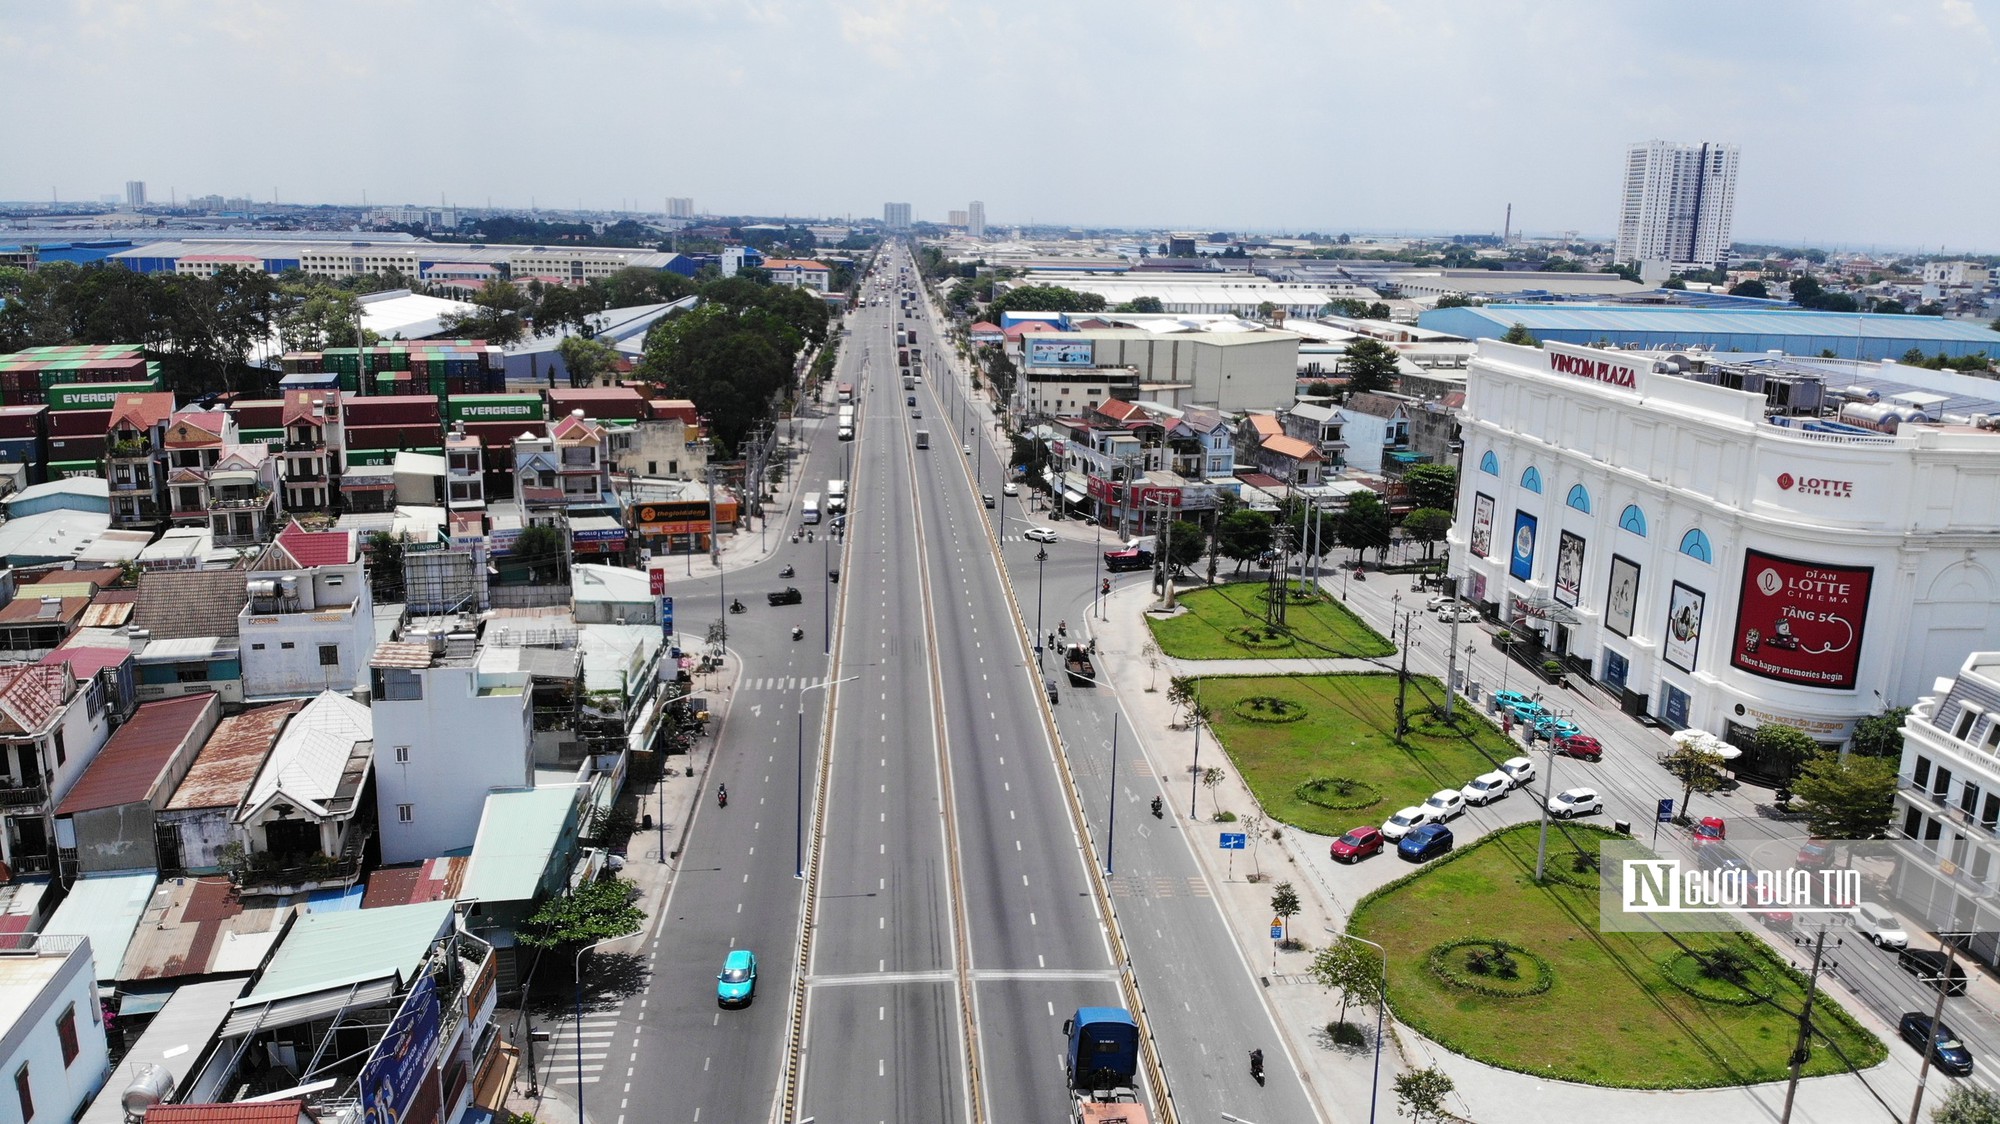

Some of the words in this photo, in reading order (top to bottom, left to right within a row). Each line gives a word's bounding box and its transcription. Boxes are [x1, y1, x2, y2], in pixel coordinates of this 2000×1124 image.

[1550, 352, 1595, 379] VINCOM
[1597, 361, 1636, 389] PLAZA
[63, 391, 118, 403] EVERGR
[461, 406, 531, 415] EVERGREEN
[1798, 476, 1853, 492] LOTTE
[1798, 487, 1851, 498] CINEMA
[1819, 573, 1837, 581] AN
[1788, 577, 1850, 596] LOTTE
[1787, 590, 1848, 604] CINEMA
[1818, 613, 1827, 622] 5
[1740, 653, 1759, 667] Where
[1759, 659, 1781, 674] happy
[1782, 666, 1820, 679] memories
[1821, 669, 1843, 682] begin
